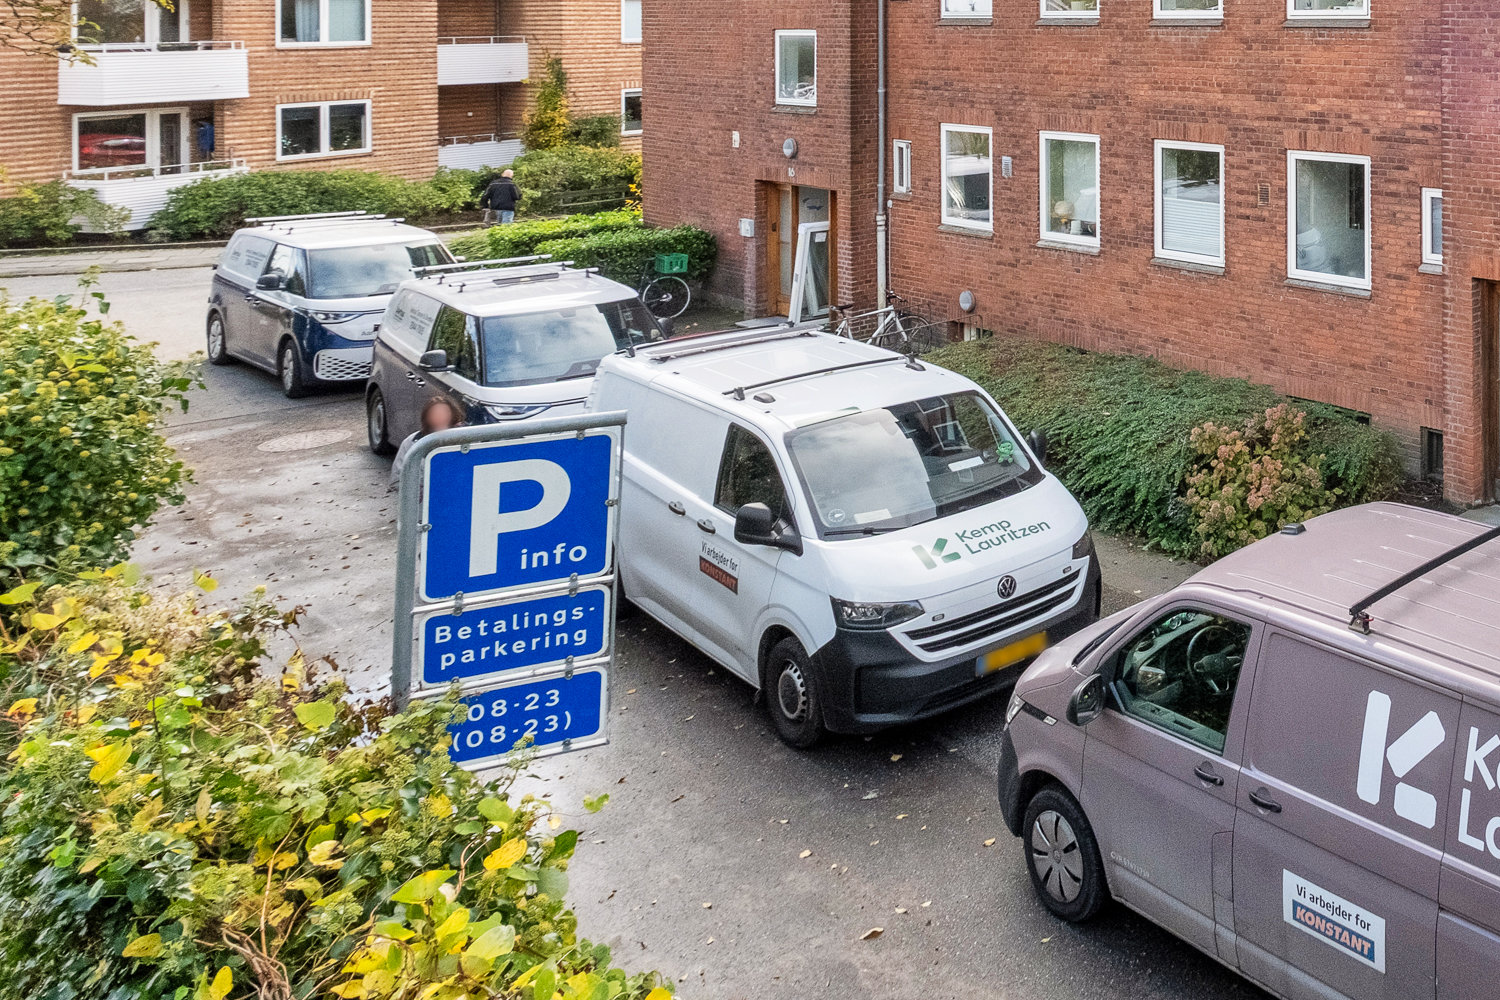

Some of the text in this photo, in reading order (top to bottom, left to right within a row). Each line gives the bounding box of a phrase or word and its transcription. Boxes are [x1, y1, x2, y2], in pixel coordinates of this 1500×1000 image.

[788, 167, 796, 177] 16
[469, 458, 571, 578] P
[954, 519, 1012, 543] Kemp
[520, 542, 587, 570] info
[964, 521, 1051, 555] Lauritzen
[434, 605, 596, 643] Betalings-
[440, 628, 588, 670] parkering
[466, 688, 560, 722] 08-23
[452, 710, 572, 752] (08-23)
[1296, 883, 1371, 931] Vi arbejder for
[1295, 906, 1371, 956] KONSTANT
